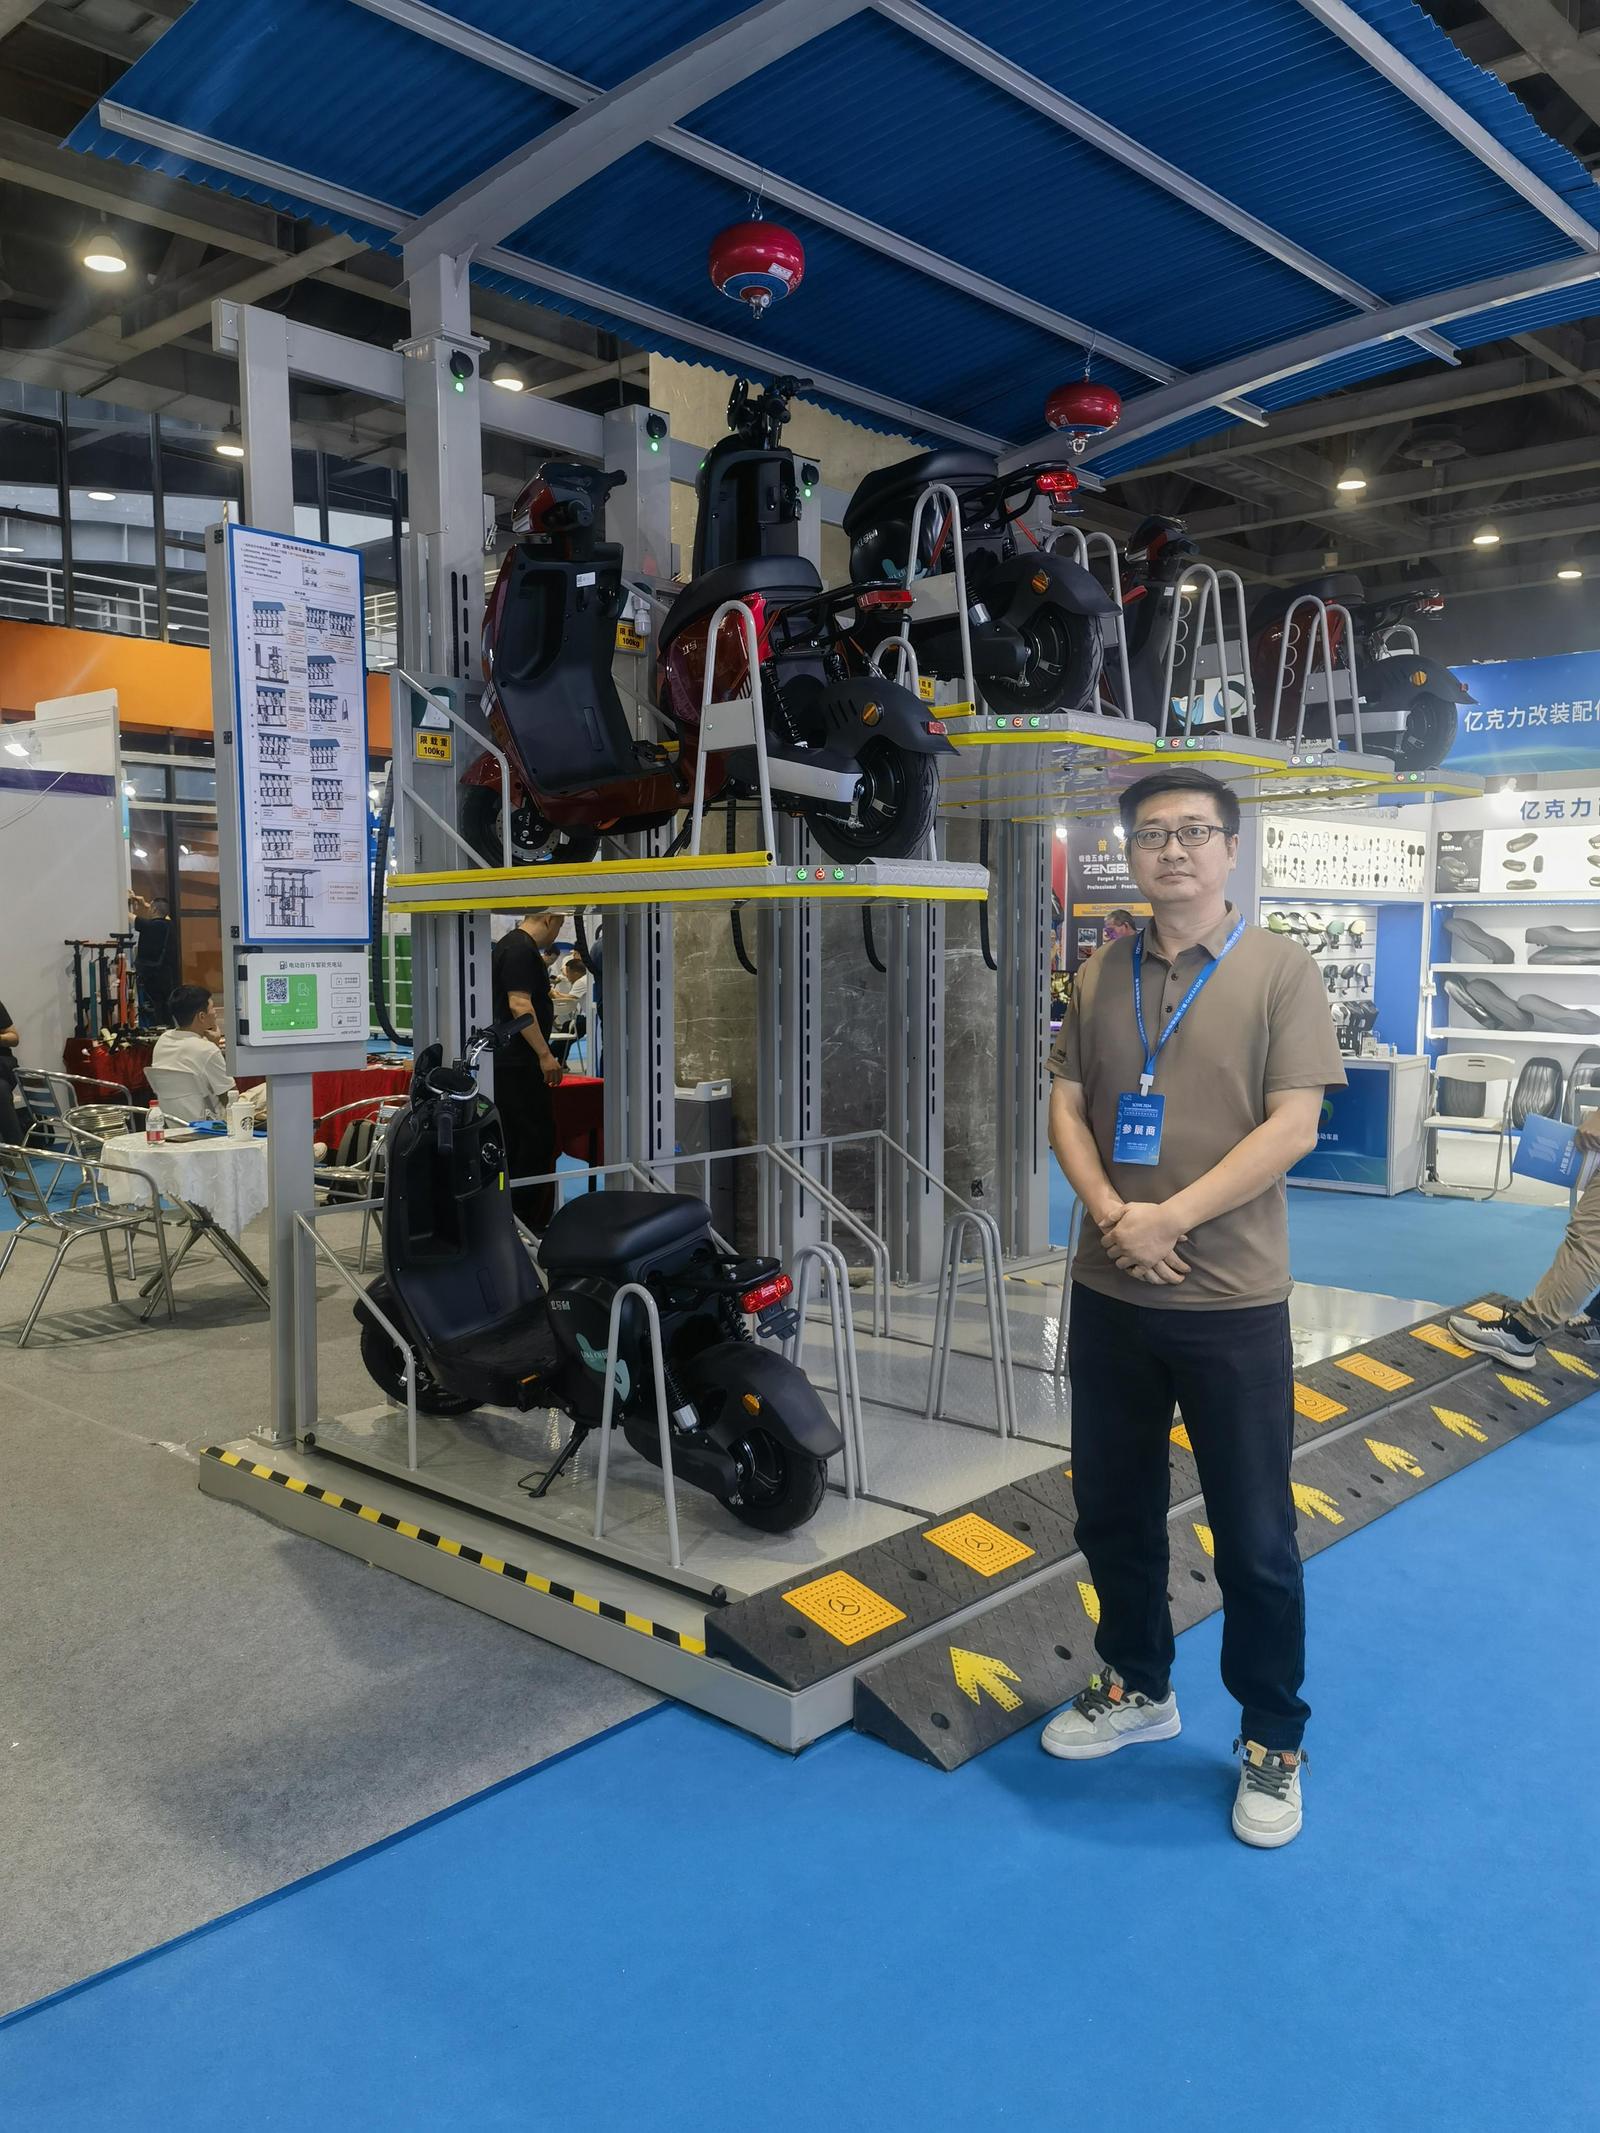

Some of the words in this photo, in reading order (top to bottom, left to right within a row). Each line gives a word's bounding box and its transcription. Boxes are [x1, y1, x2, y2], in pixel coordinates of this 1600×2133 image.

[623, 637, 640, 648] 100kg
[420, 735, 448, 747] 限载重
[423, 747, 445, 758] 100kg
[1520, 797, 1600, 820] 亿克力
[1122, 1124, 1156, 1136] 参展商
